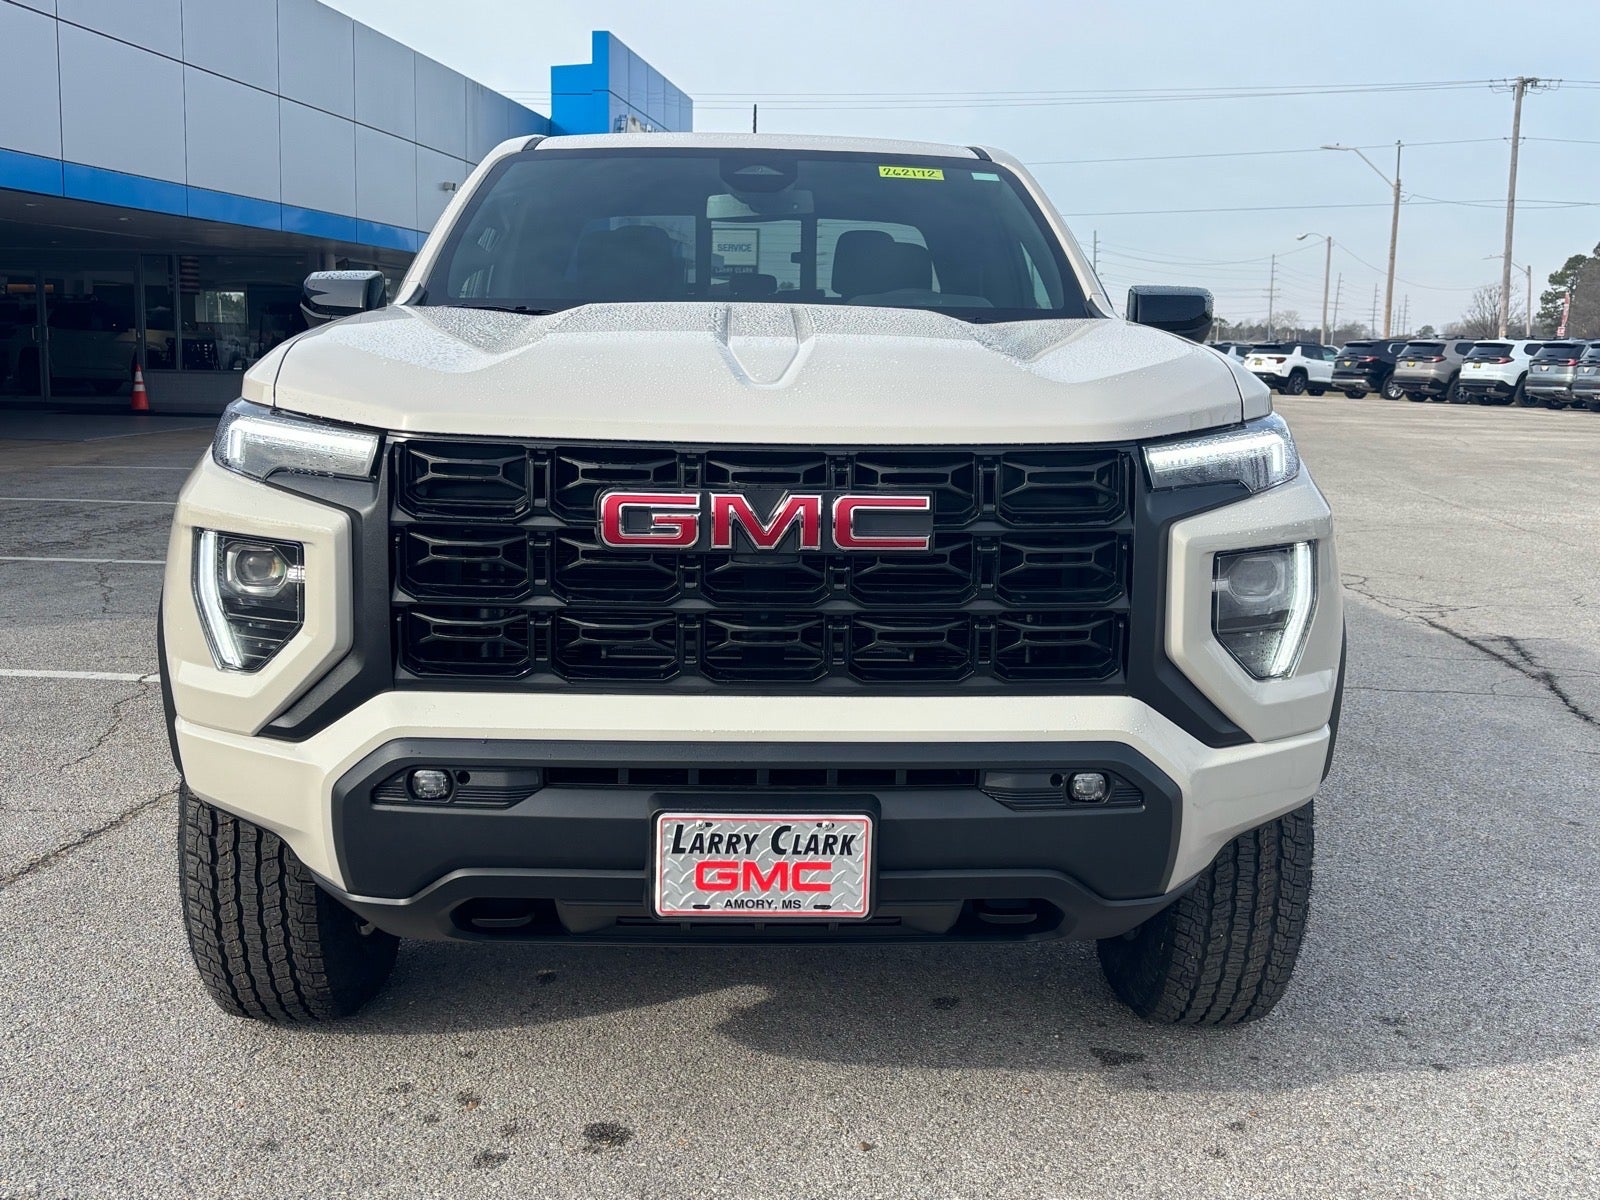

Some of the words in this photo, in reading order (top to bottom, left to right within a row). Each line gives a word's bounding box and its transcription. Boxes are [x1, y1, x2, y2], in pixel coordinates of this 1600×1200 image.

[717, 244, 753, 252] SERVICE
[600, 492, 933, 550] GMC
[671, 824, 759, 854] LARRY
[770, 825, 856, 855] CLARK
[695, 861, 832, 892] GMC
[724, 900, 778, 910] AMORY,
[781, 900, 802, 909] MS
